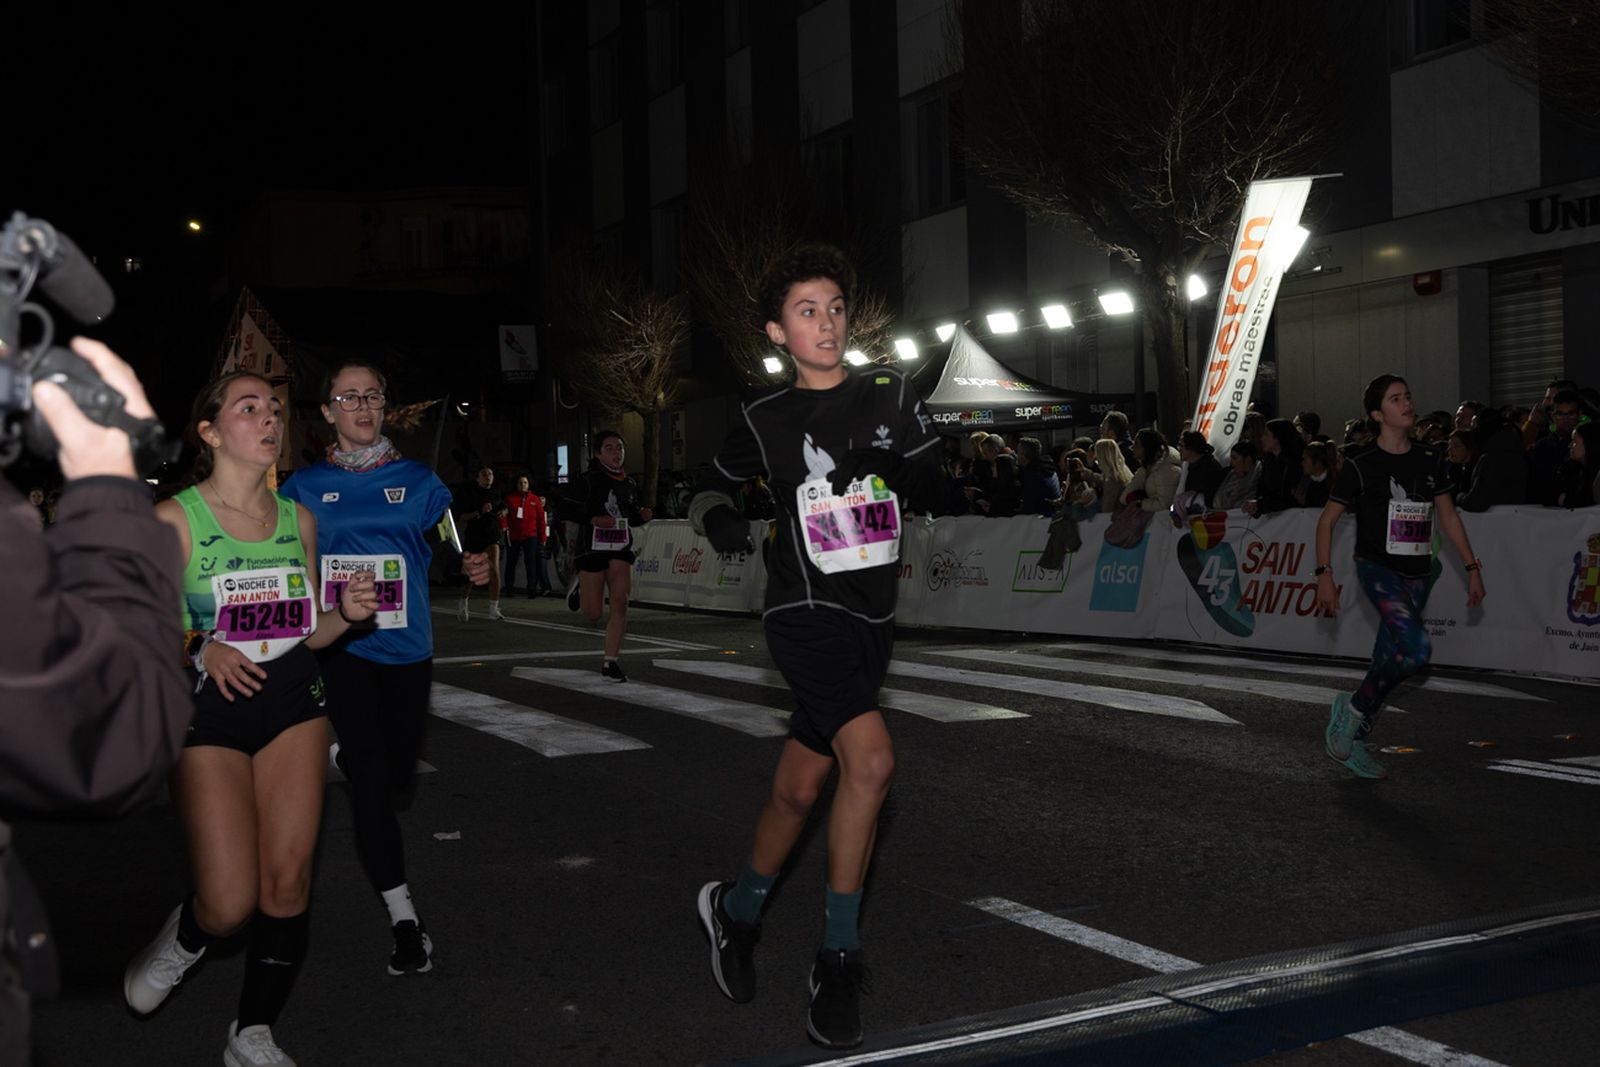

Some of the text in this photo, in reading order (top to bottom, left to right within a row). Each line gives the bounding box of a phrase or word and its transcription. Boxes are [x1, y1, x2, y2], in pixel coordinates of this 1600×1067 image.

[1223, 276, 1273, 436] obras maestras
[852, 483, 864, 493] DE
[1242, 541, 1305, 576] SAN
[340, 563, 365, 571] NOCHE
[1100, 561, 1138, 585] alsa
[331, 573, 348, 581] SAN
[1197, 555, 1236, 607] 43
[238, 579, 279, 591] NOCHE DE
[227, 594, 247, 604] SAN
[227, 600, 304, 632] 15249
[1569, 642, 1580, 650] de
